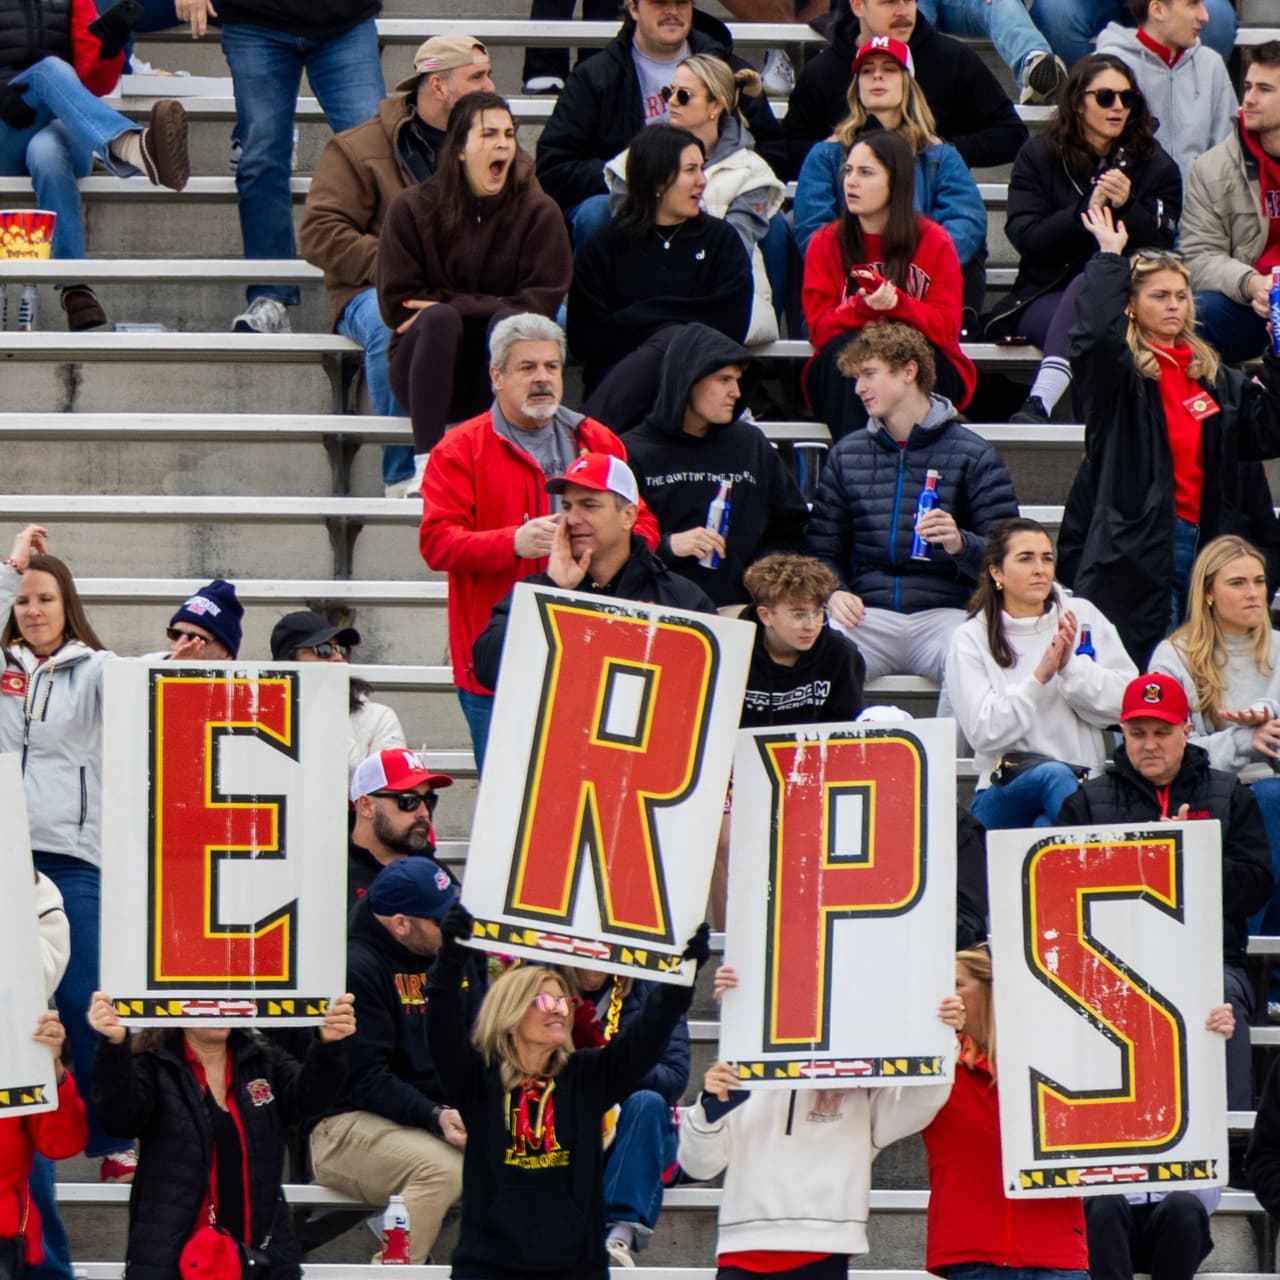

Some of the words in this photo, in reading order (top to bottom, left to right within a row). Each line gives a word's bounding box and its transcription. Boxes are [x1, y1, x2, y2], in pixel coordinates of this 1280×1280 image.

[872, 37, 889, 48] M
[147, 668, 300, 991] E
[504, 593, 721, 946] R
[754, 728, 928, 1053] P
[1023, 829, 1190, 1161] S
